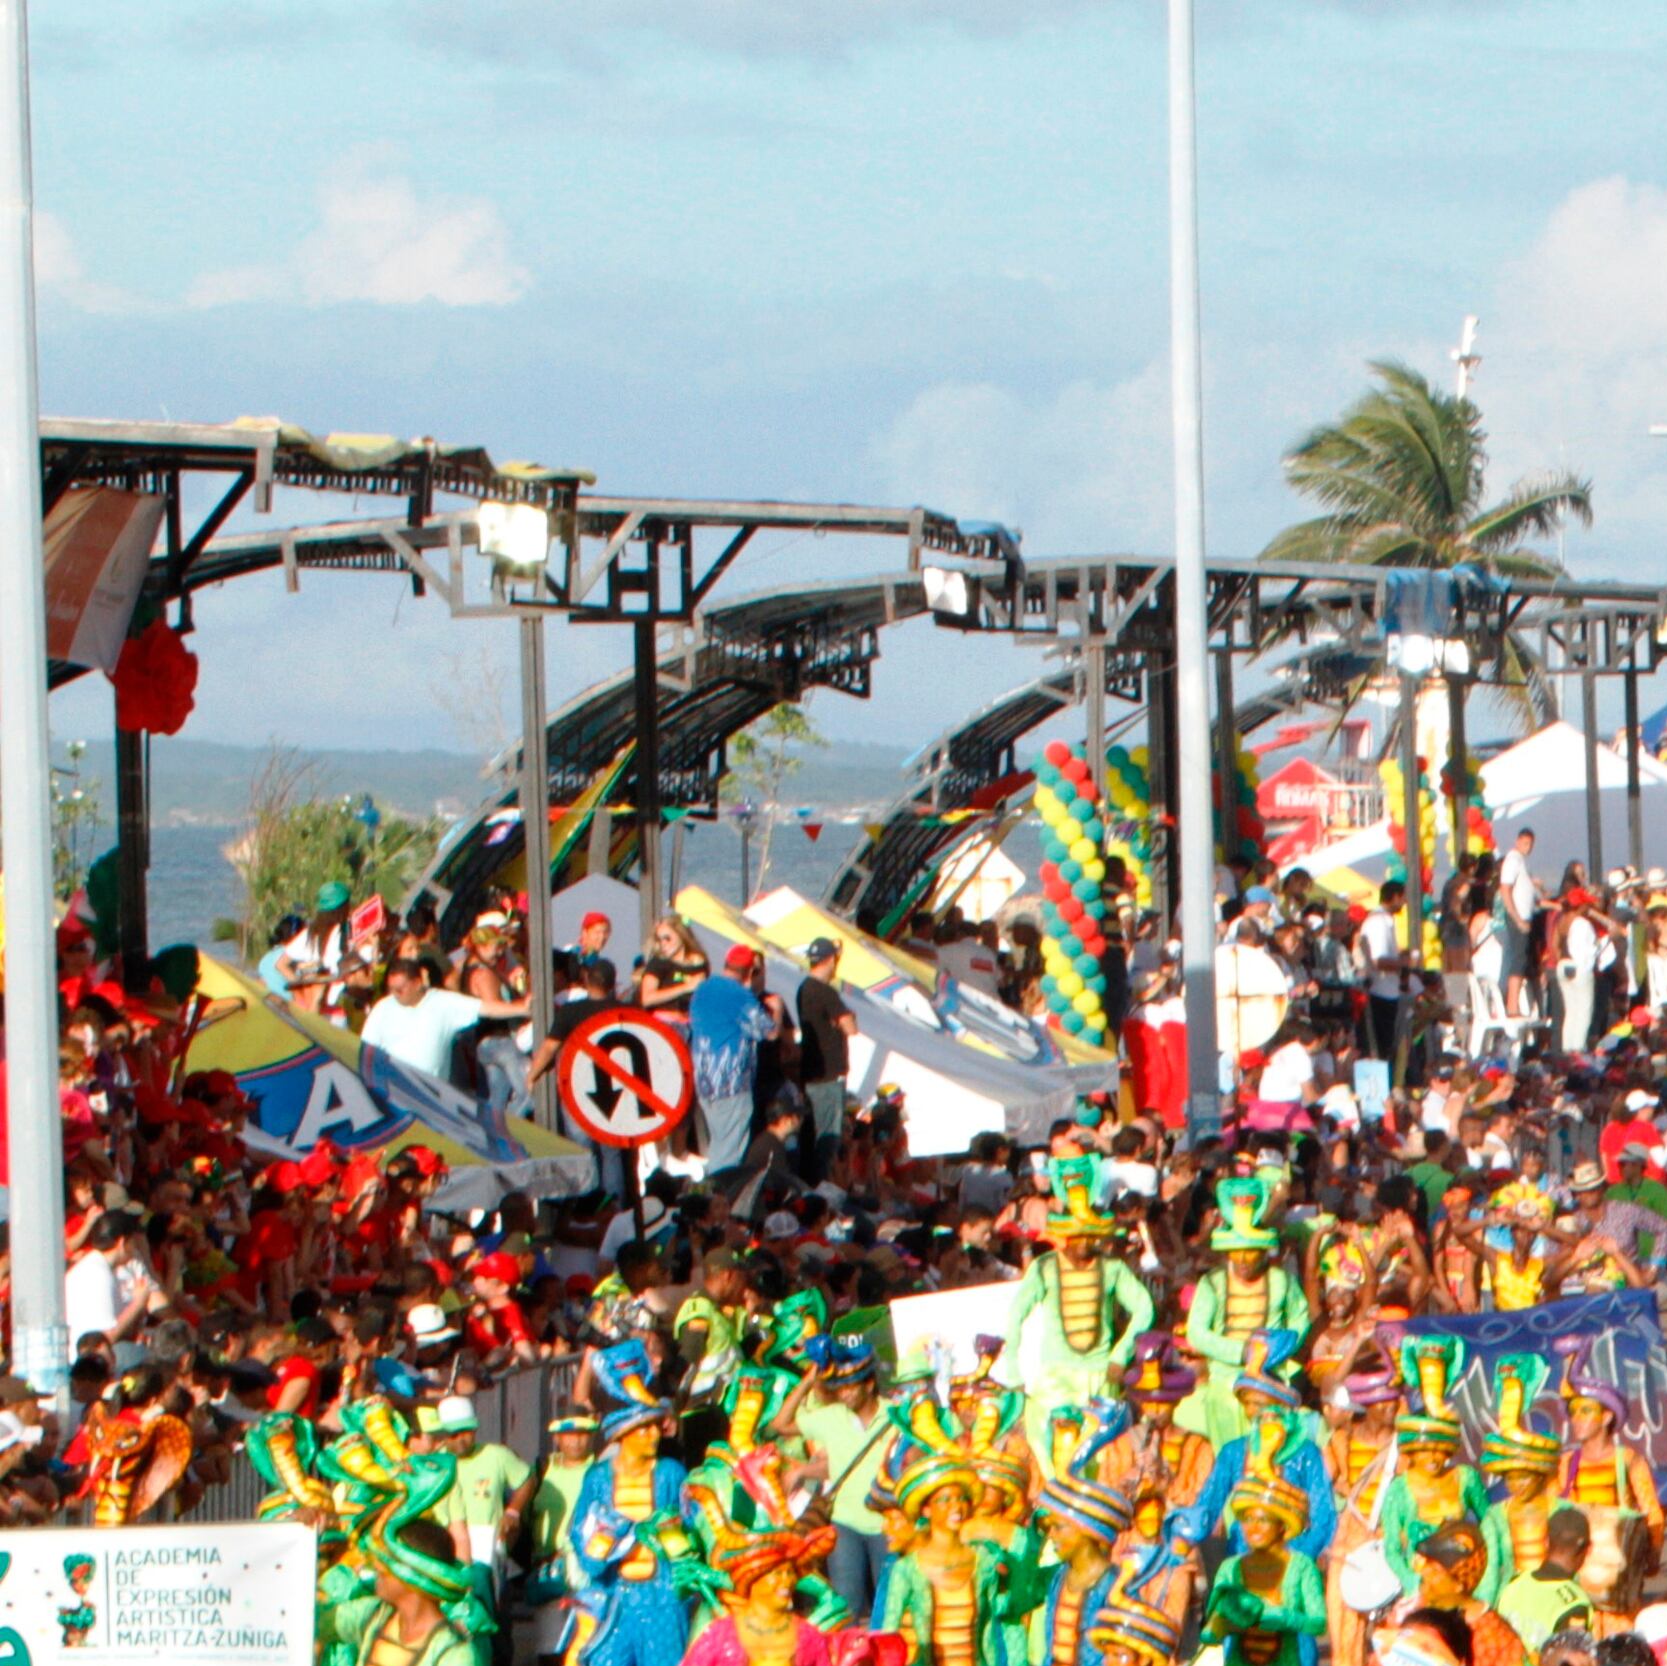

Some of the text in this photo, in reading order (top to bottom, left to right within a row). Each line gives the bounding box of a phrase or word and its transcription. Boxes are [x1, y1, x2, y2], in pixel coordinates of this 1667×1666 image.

[114, 1546, 222, 1567] ACADEMIA
[115, 1569, 141, 1586] DE
[115, 1584, 232, 1606] EXPRESIÓN
